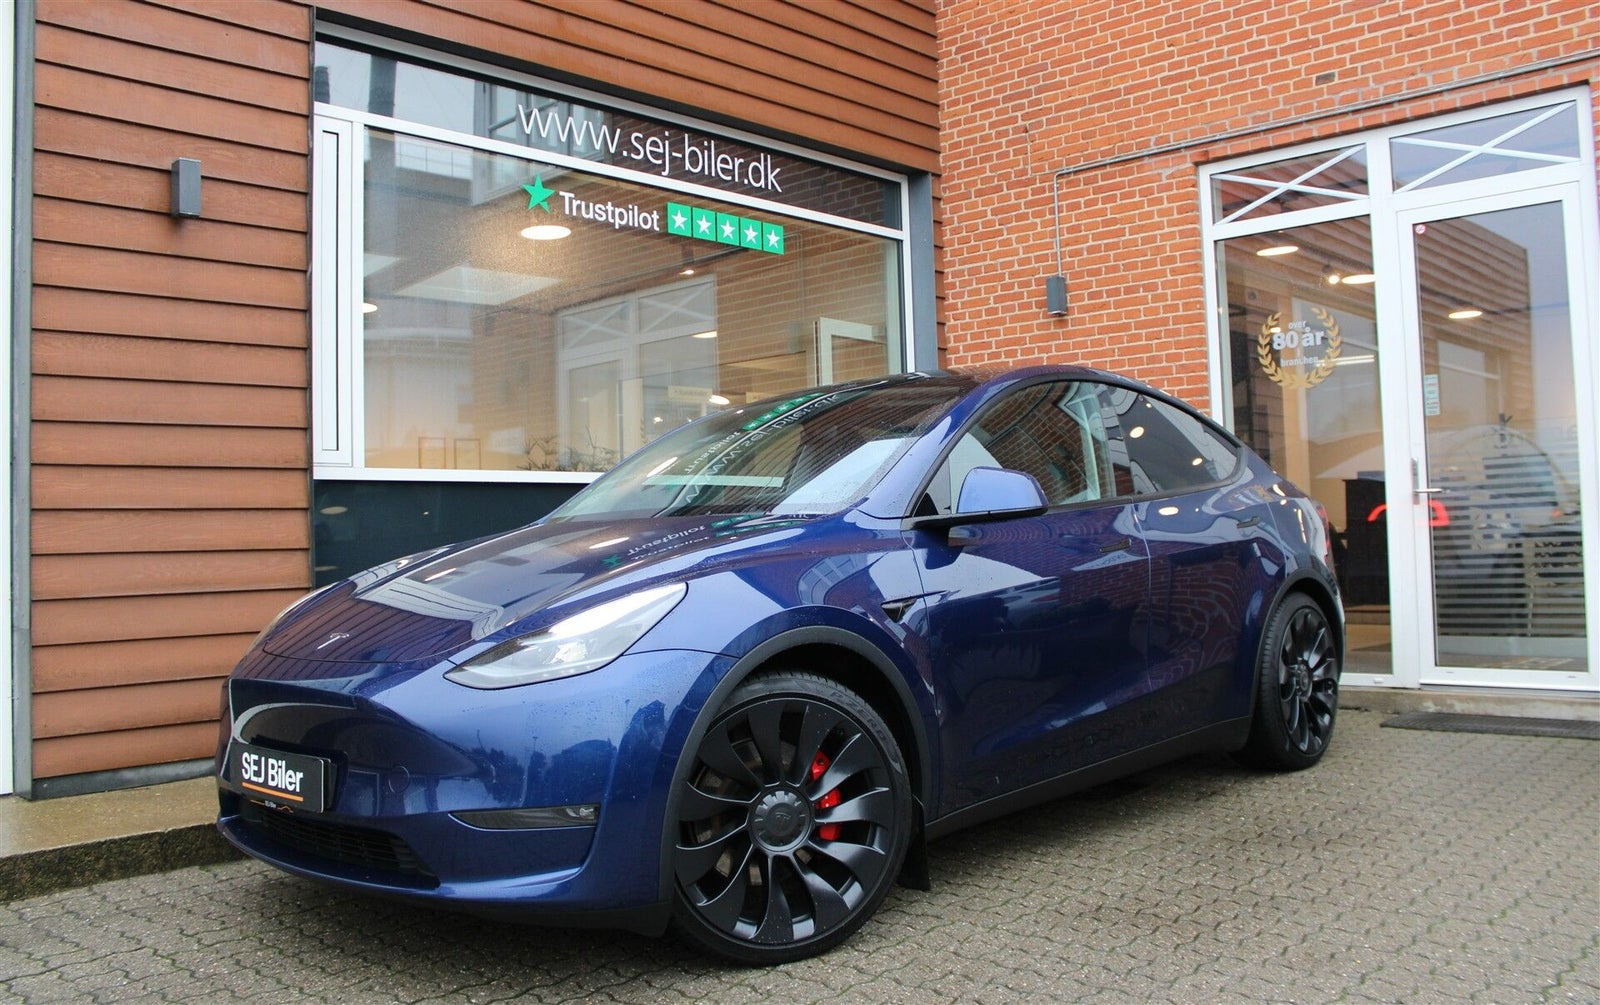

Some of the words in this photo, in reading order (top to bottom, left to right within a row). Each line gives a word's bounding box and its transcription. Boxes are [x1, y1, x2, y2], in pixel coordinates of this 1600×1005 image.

[518, 103, 783, 193] www.sej-biler.dk
[559, 191, 660, 232] Trustpilot
[1272, 330, 1299, 350] 80
[1301, 326, 1325, 347] år
[1288, 320, 1307, 330] over
[241, 751, 265, 784] SEJ
[267, 758, 304, 793] Biler
